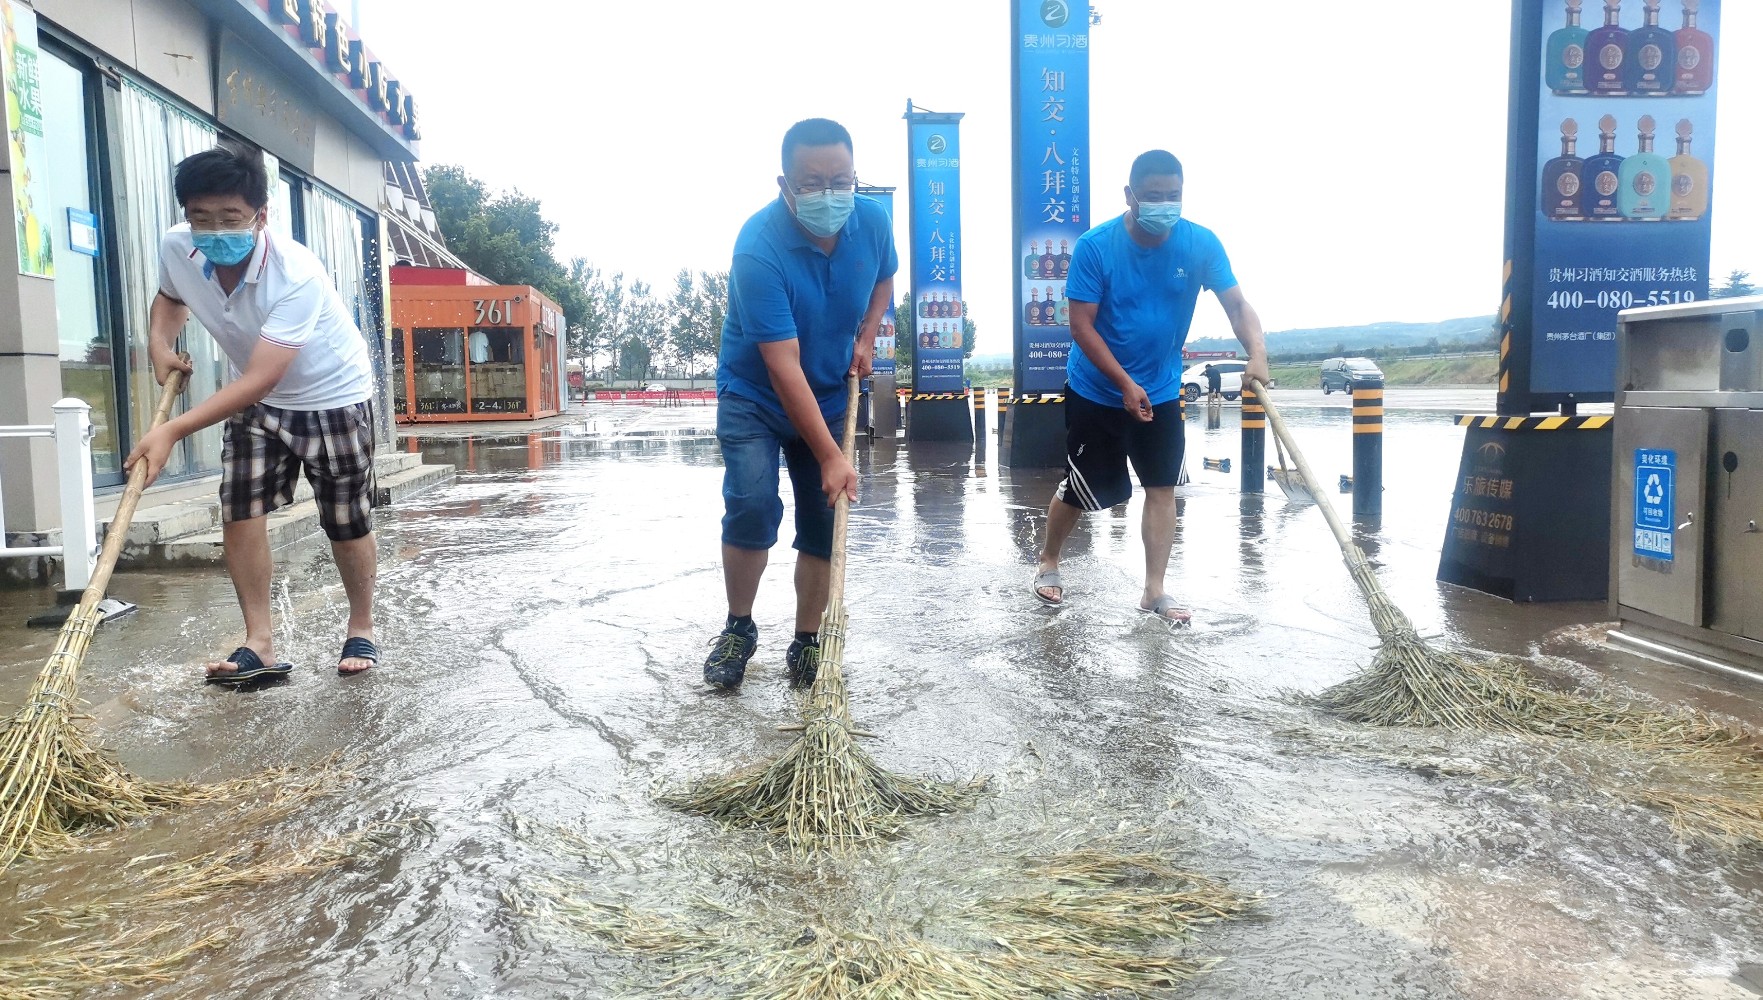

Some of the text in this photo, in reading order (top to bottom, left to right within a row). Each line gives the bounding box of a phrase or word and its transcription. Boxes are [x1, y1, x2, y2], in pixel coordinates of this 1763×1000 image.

[1023, 34, 1088, 48] 贵州习酒
[916, 157, 959, 168] 贵州习酒
[1071, 147, 1080, 212] 文化特色创意酒
[1549, 267, 1698, 282] 贵州习酒知交酒服务热线
[1546, 290, 1696, 309] 400-080-5519
[1641, 454, 1668, 465] 美化环境
